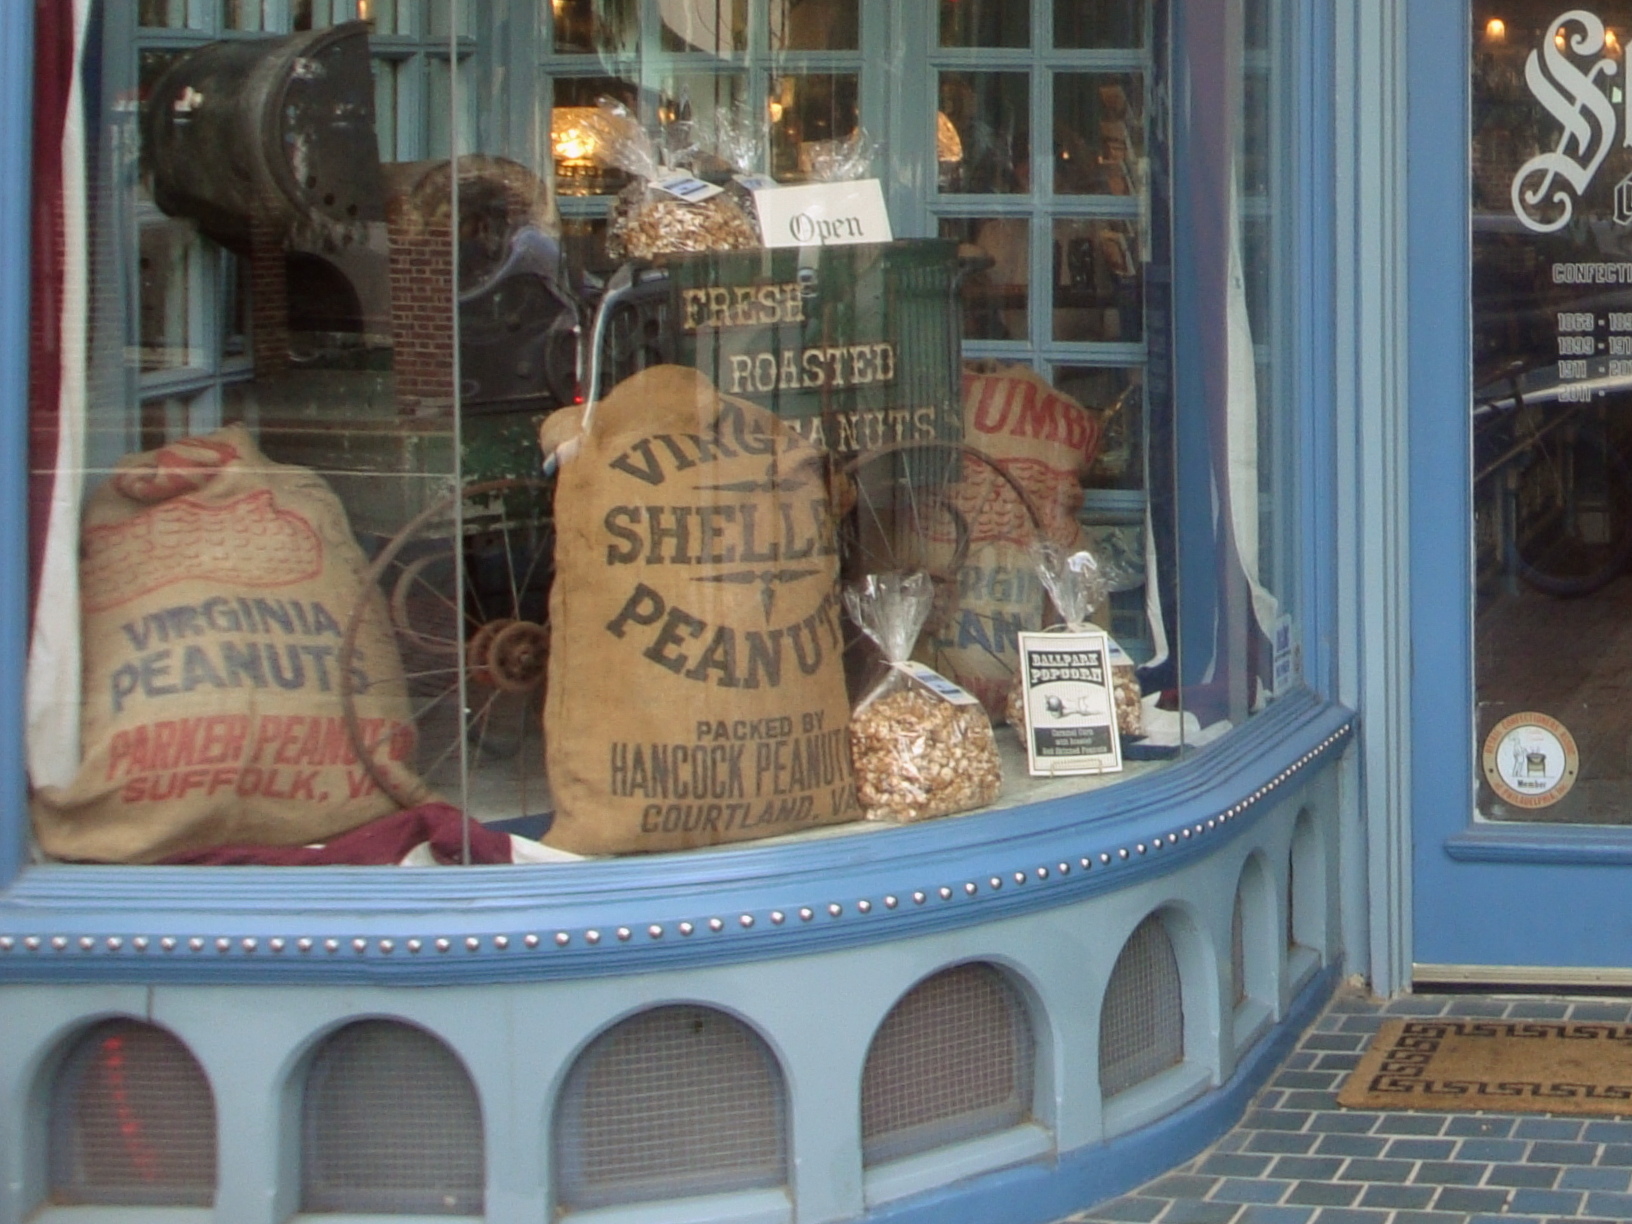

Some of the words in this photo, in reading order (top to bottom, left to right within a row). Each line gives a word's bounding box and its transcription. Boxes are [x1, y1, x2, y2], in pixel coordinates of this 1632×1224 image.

[789, 212, 864, 244] Open
[683, 282, 806, 330] FRESH
[729, 343, 896, 395] ROASTED
[1558, 360, 1588, 379] 1911
[1558, 384, 1592, 403] 2011
[783, 407, 936, 452] ANUTS
[962, 375, 1101, 464] UMBO
[123, 595, 342, 652] VIRGINIA
[110, 640, 369, 713] PEANUTS
[1031, 653, 1099, 667] BALLPARK
[105, 714, 249, 782] PARKER
[696, 716, 793, 742] PACKED
[802, 710, 825, 734] BY
[121, 766, 330, 805] SUFFOLK,
[611, 742, 744, 800] HANCOCK
[1517, 779, 1547, 789] Member
